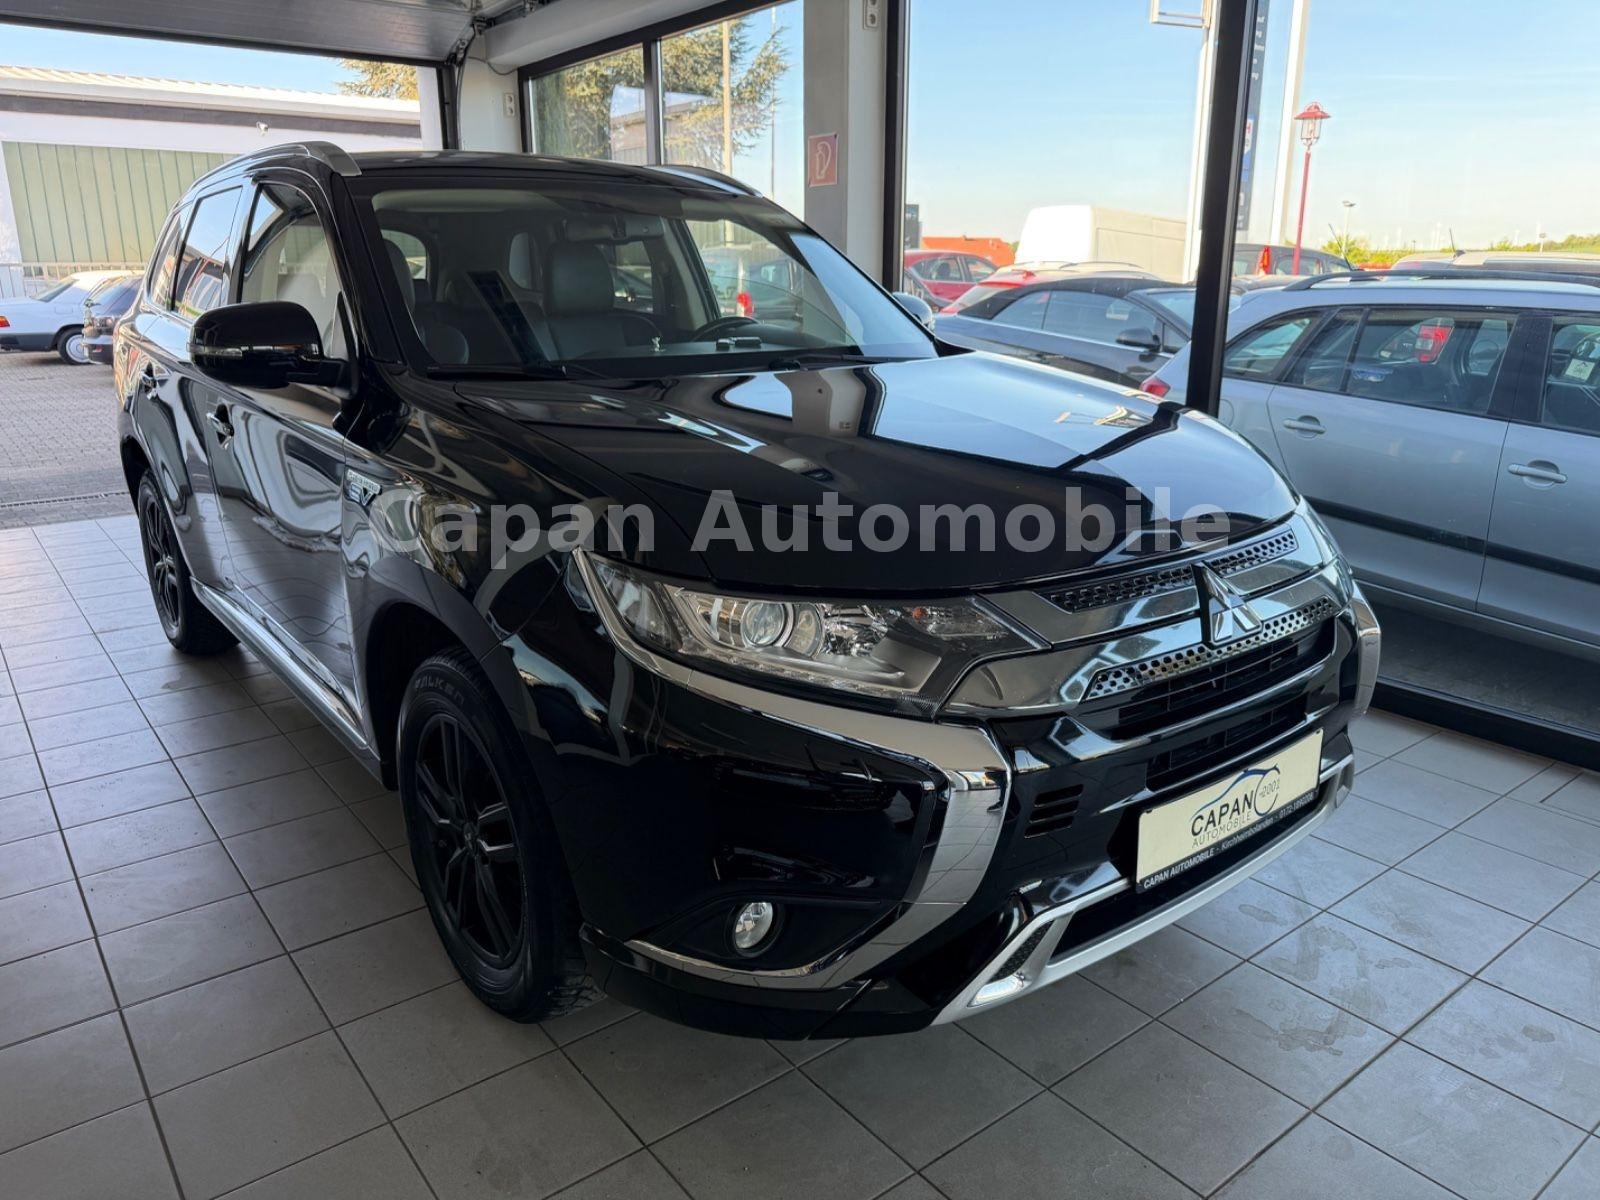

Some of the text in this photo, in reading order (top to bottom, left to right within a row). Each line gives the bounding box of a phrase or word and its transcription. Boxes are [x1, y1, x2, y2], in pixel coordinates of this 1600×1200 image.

[1191, 789, 1254, 837] CAPAN
[1192, 810, 1252, 849] AUTOMOBILE
[1143, 869, 1169, 889] CAPAN
[1169, 847, 1214, 878] AUTOMOBILE
